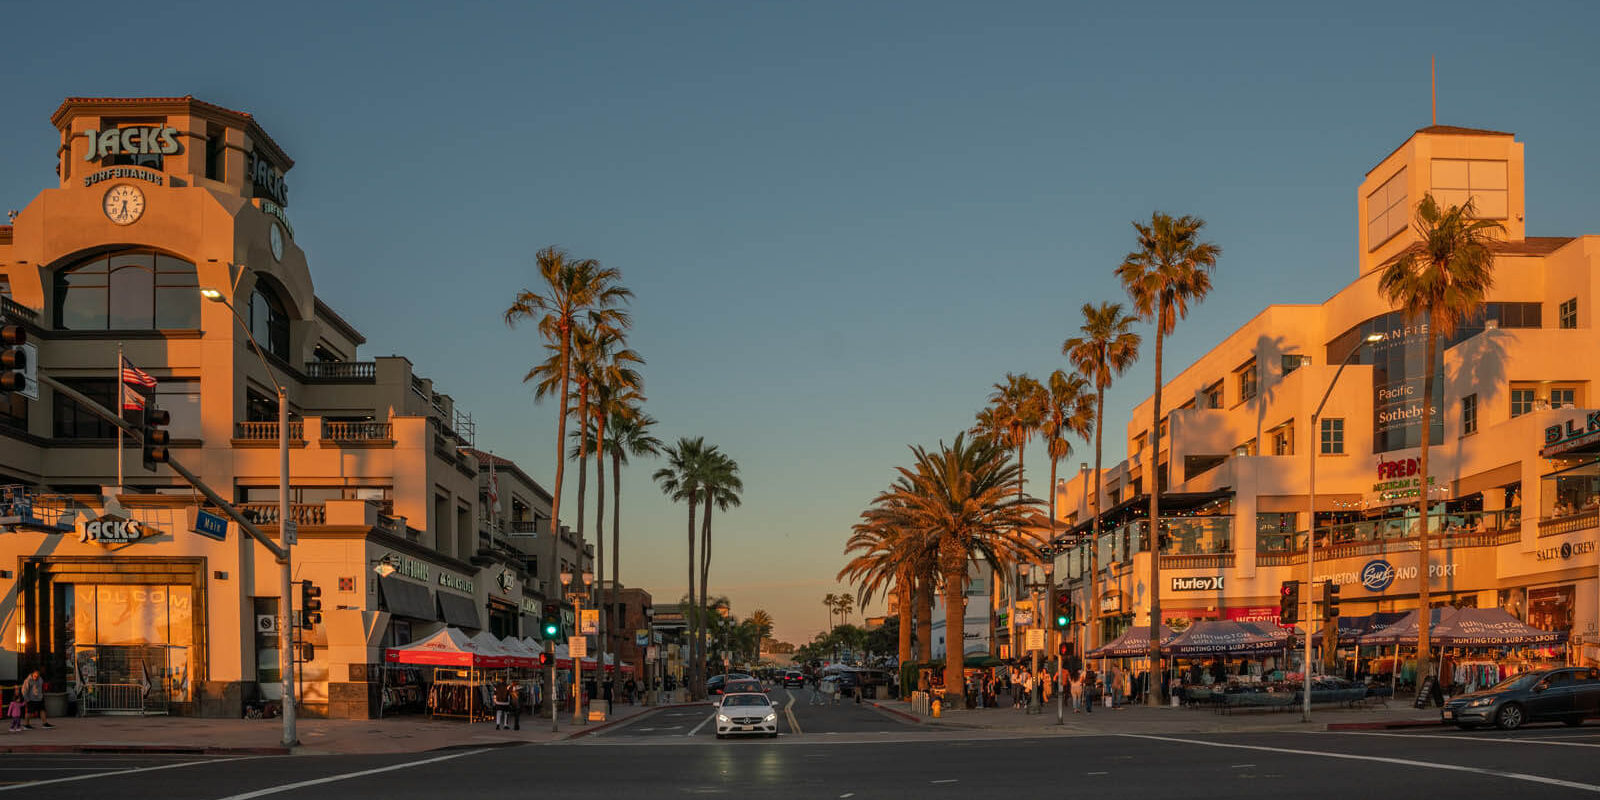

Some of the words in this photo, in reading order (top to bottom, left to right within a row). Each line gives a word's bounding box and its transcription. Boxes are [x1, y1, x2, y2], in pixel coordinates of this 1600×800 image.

[85, 123, 180, 162] JACK'S
[83, 168, 163, 187] SURFBOARDS
[1379, 385, 1414, 400] Pacific
[78, 518, 140, 543] JACK'S
[204, 518, 221, 533] Main
[1573, 541, 1597, 555] CREW
[1395, 566, 1418, 579] AND
[1429, 564, 1458, 577] PORT
[1173, 578, 1212, 590] Hurley
[79, 590, 188, 609] VOLCOM
[1180, 645, 1226, 653] HUNTINGTON
